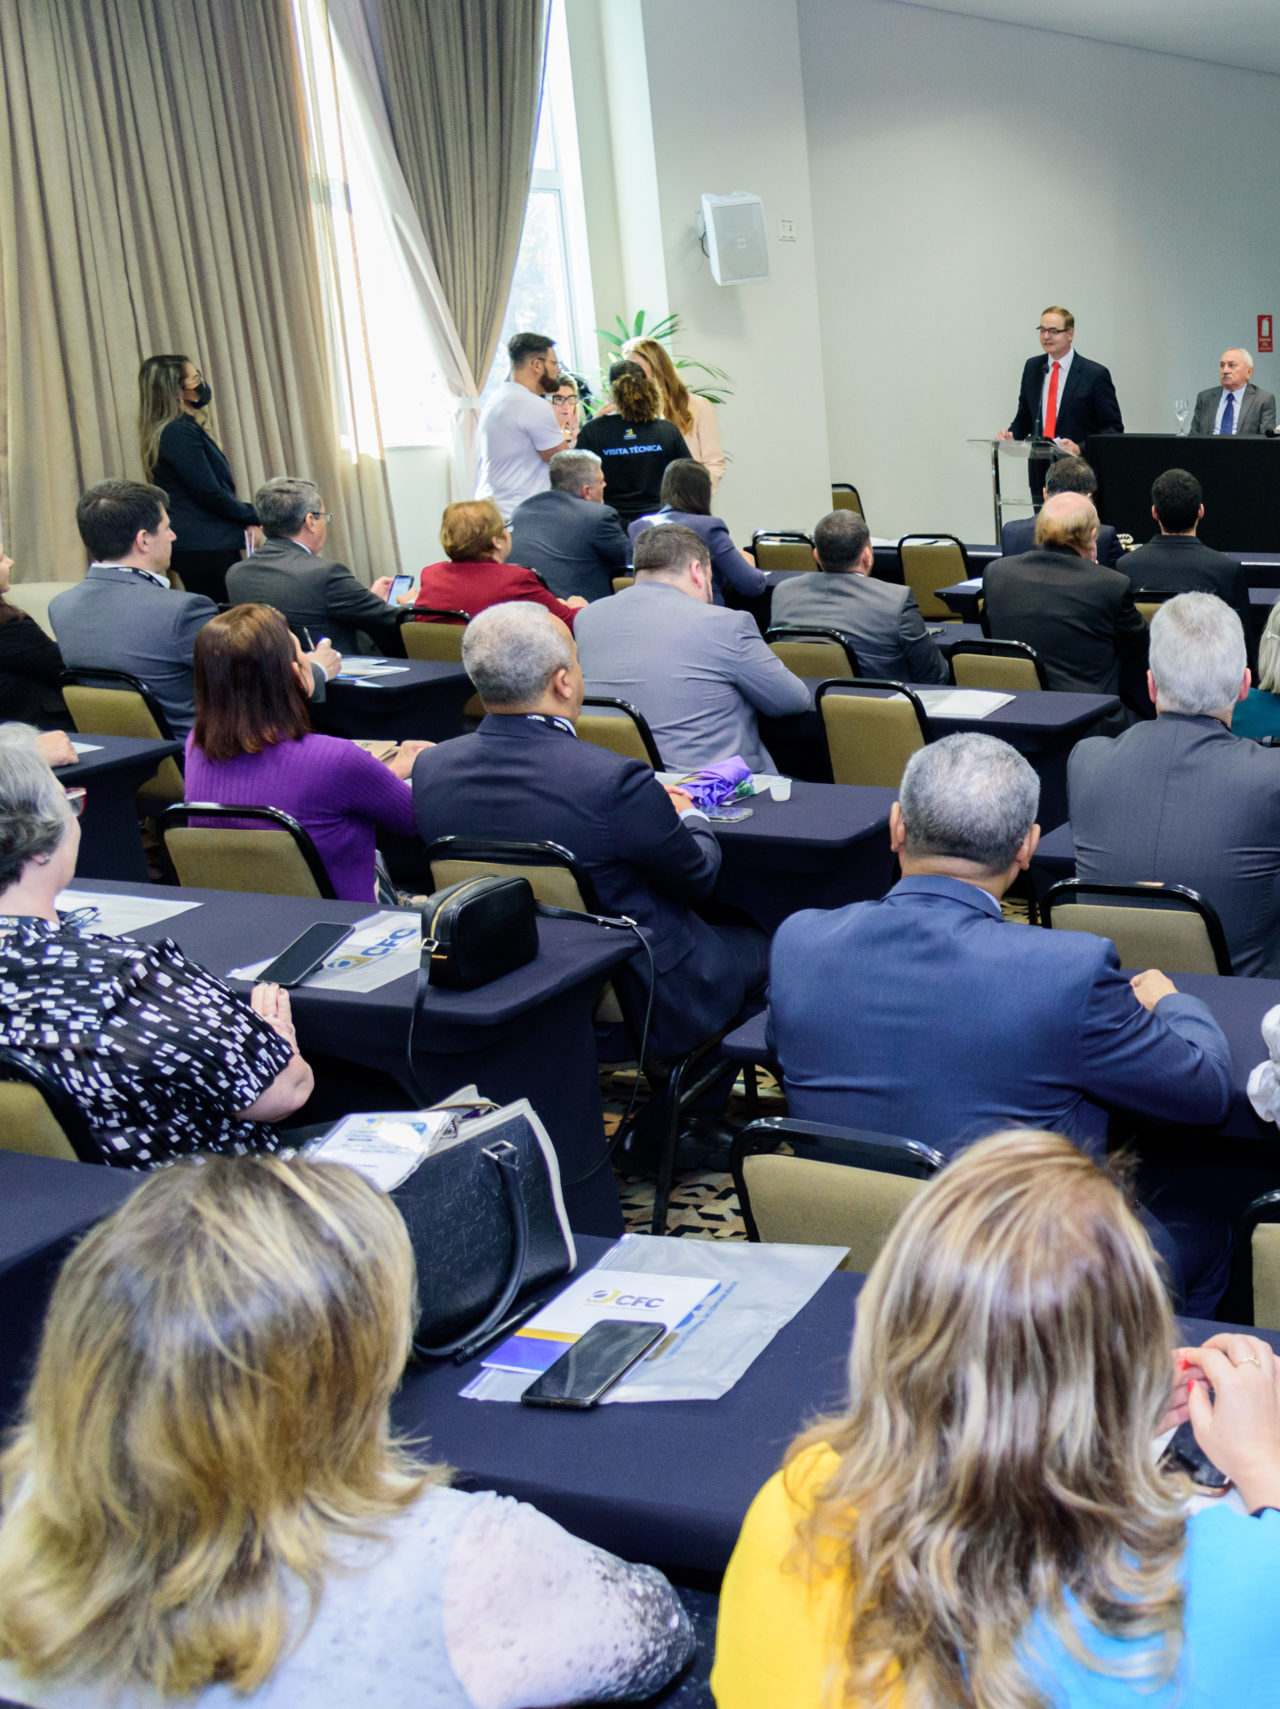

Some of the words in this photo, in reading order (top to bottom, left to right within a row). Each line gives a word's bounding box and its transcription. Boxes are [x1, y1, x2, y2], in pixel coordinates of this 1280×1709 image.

[602, 447, 629, 456] VISITA
[629, 444, 663, 454] TÉCNICA
[360, 928, 418, 957] CFC
[615, 1294, 665, 1308] CFC
